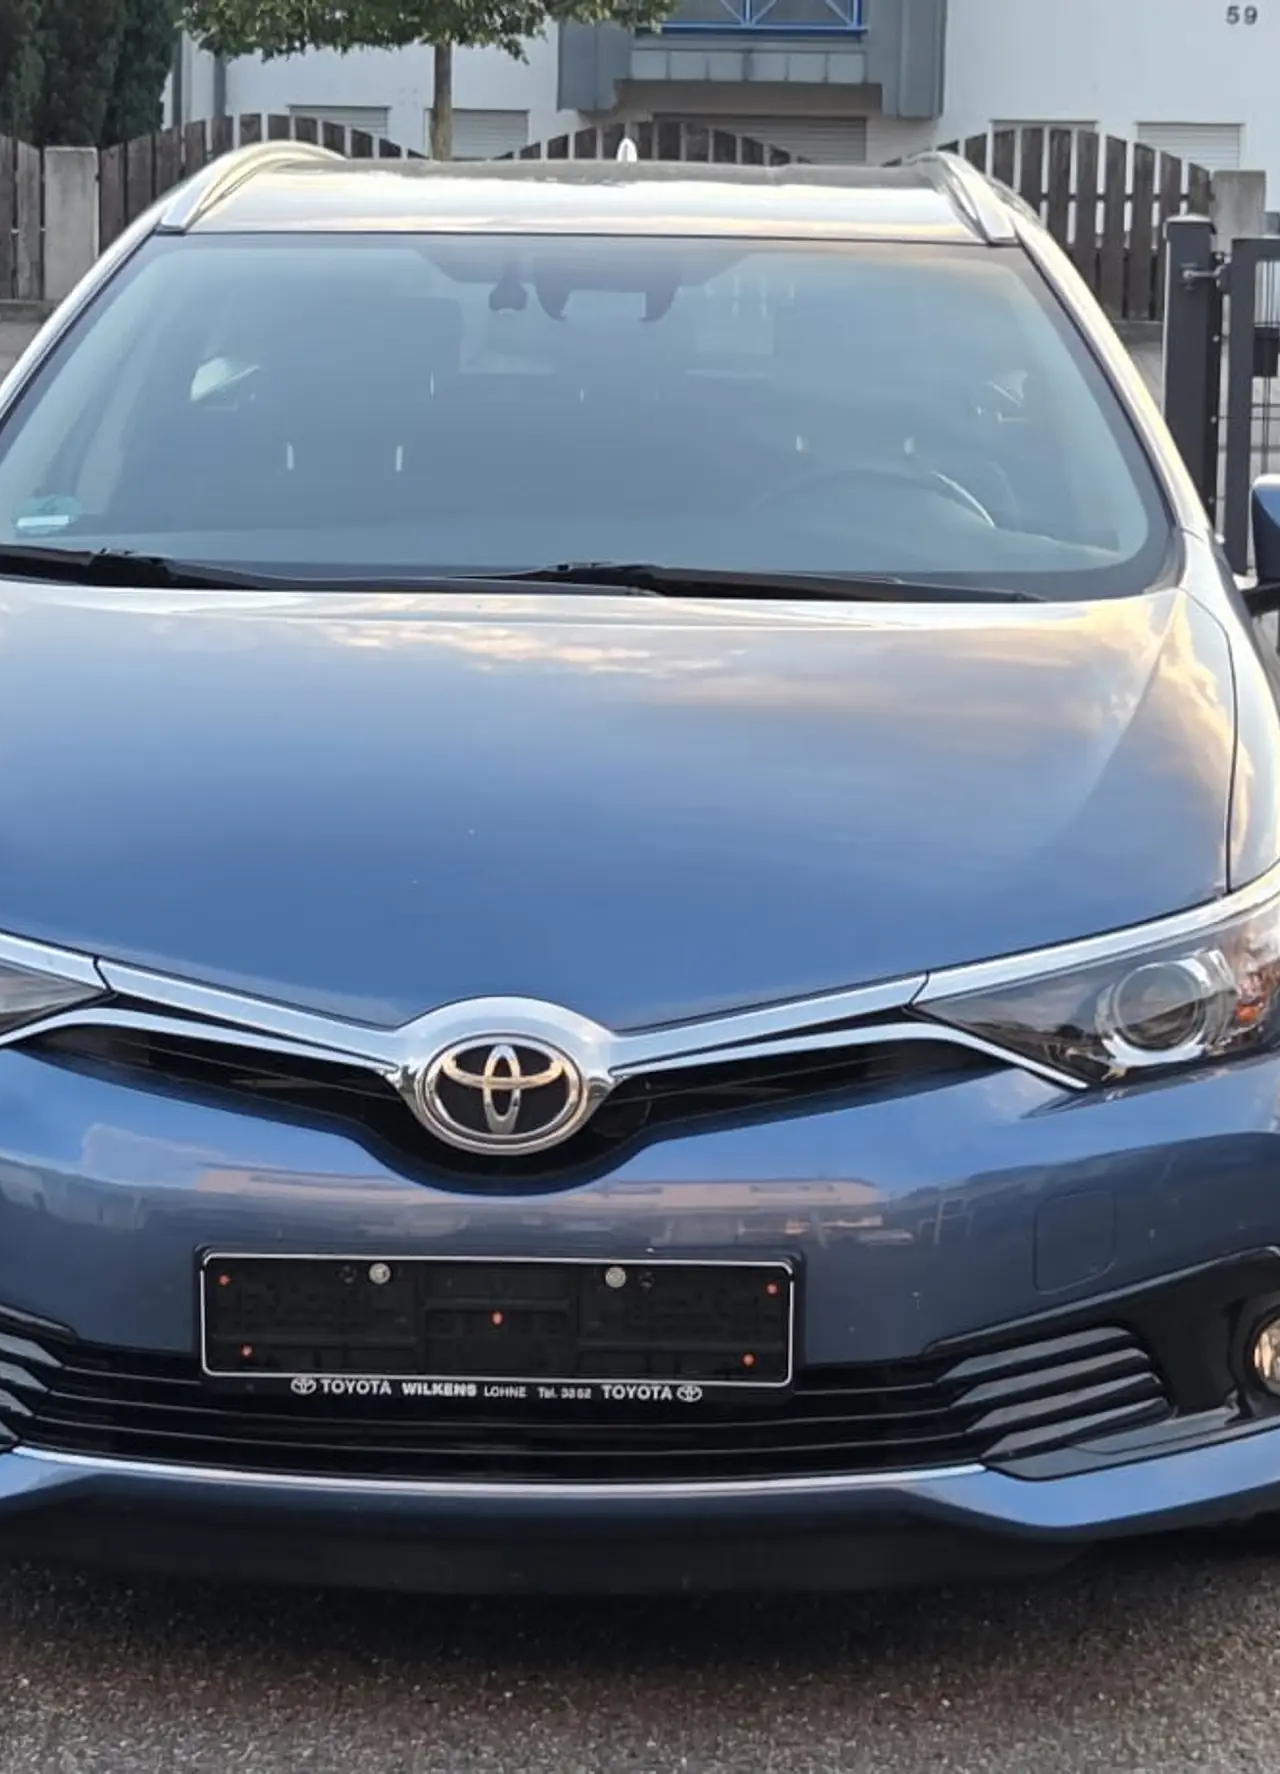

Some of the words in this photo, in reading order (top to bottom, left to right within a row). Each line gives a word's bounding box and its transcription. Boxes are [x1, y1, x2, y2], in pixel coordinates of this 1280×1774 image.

[1226, 5, 1258, 25] 59
[321, 1379, 392, 1395] TOYOTA
[402, 1382, 477, 1397] WILKENS
[601, 1384, 673, 1401] TOYOTA
